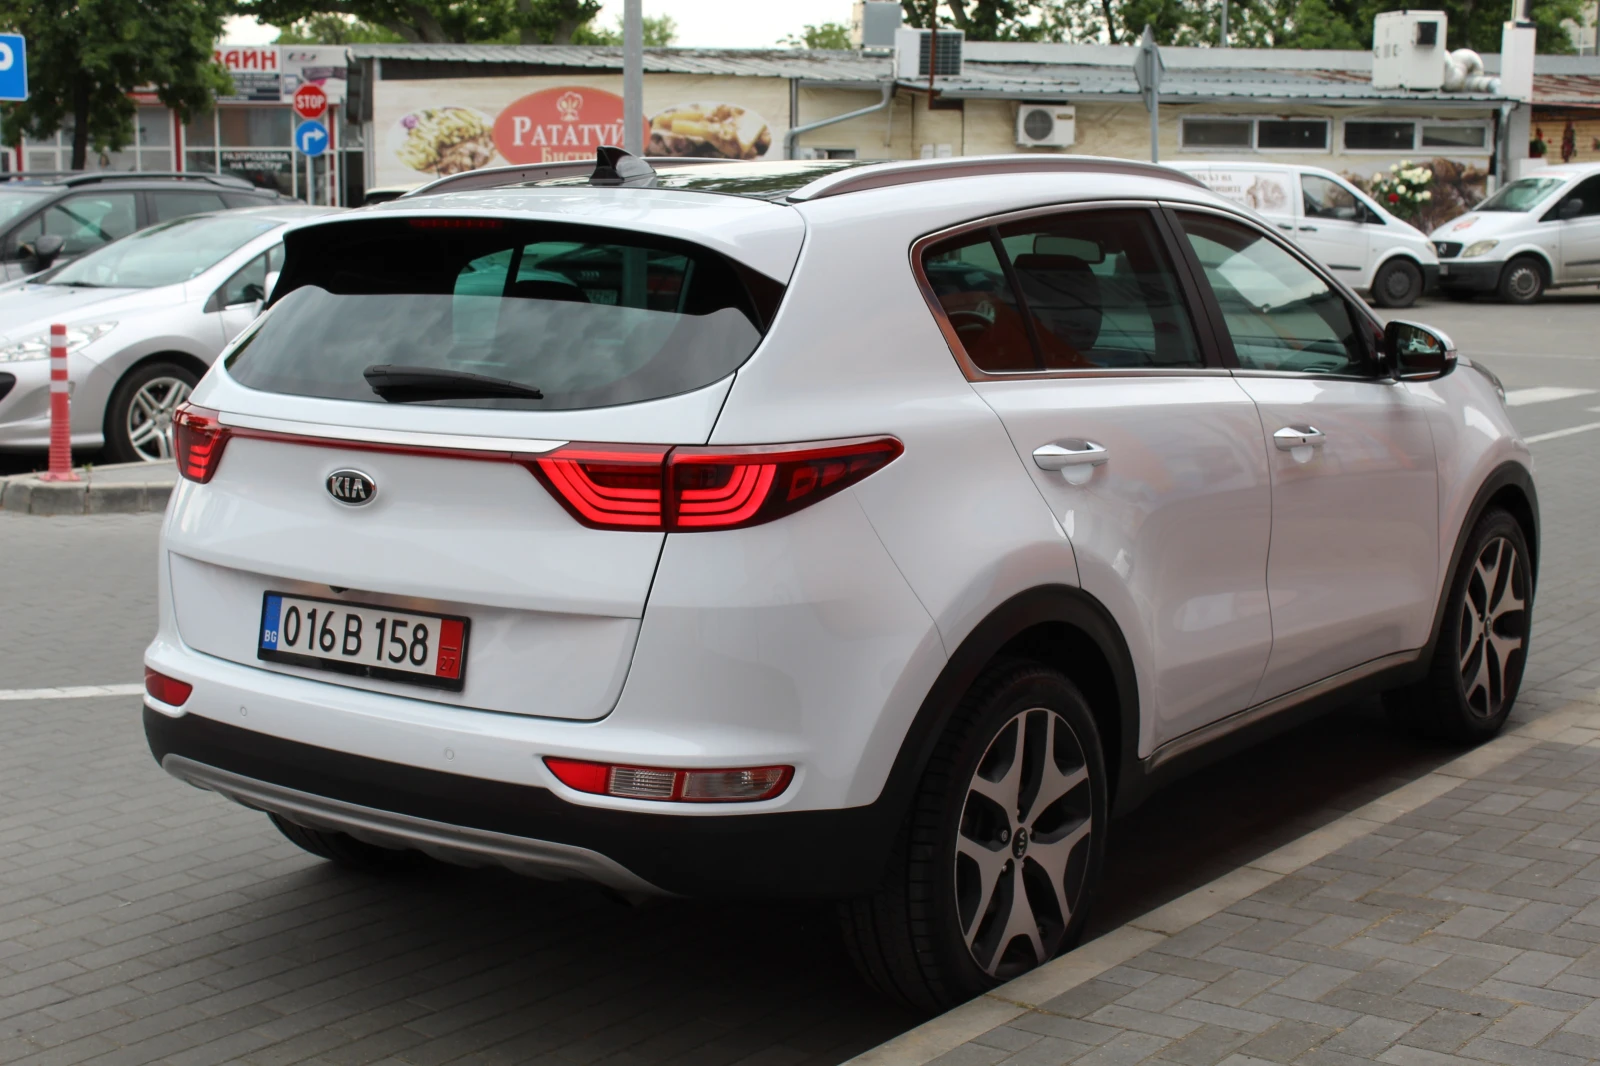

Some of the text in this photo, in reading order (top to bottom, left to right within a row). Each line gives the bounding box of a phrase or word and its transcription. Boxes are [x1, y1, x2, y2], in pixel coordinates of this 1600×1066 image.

[296, 95, 325, 109] STOP
[331, 476, 367, 499] KIA
[264, 629, 277, 643] BG
[440, 655, 456, 671] 27
